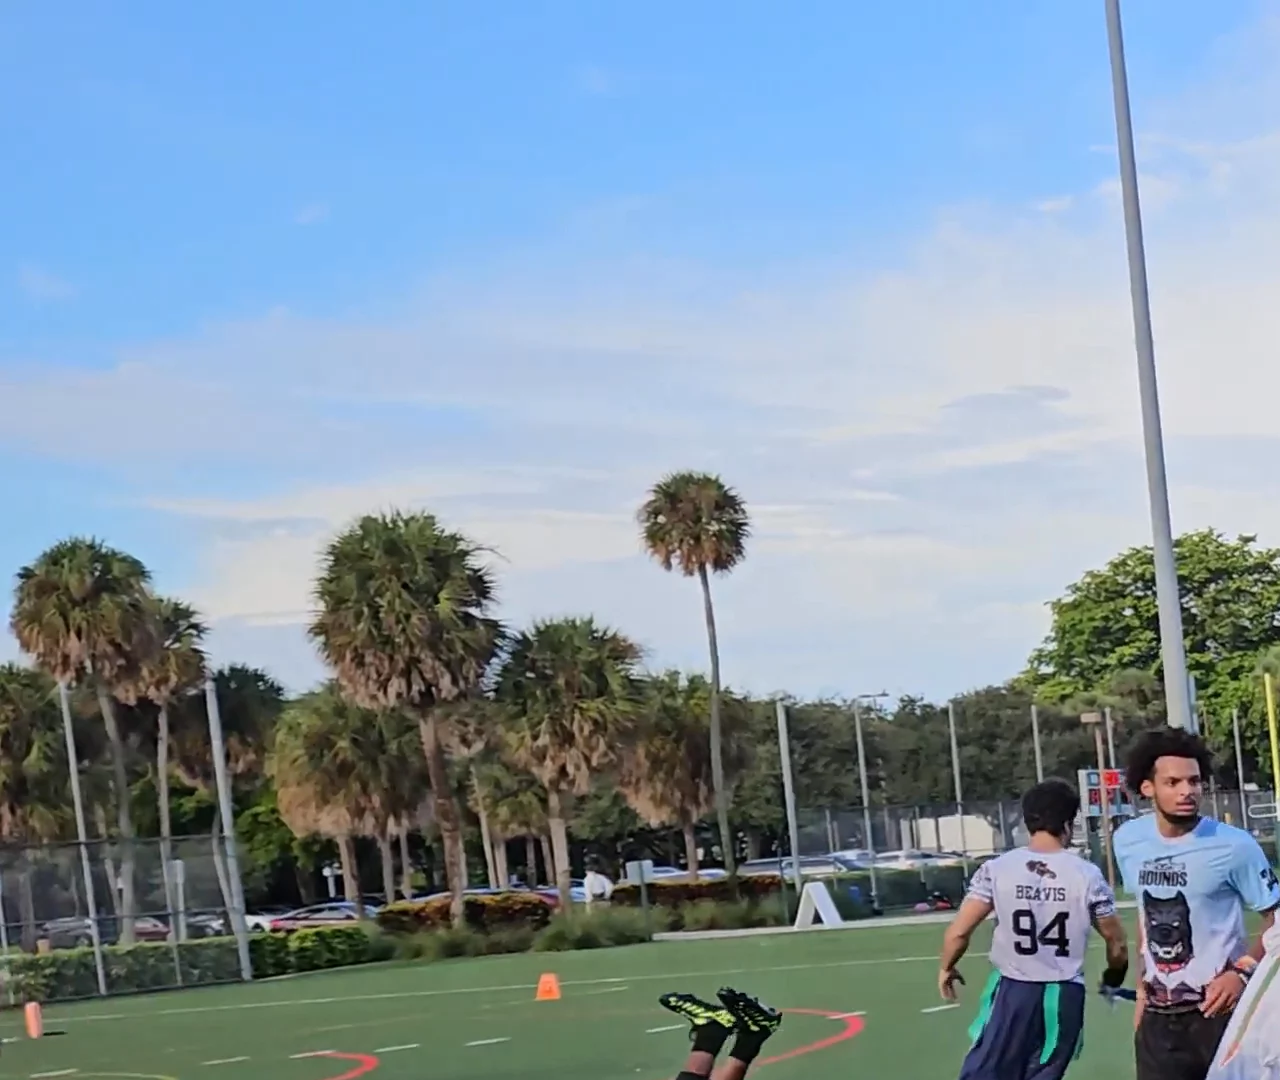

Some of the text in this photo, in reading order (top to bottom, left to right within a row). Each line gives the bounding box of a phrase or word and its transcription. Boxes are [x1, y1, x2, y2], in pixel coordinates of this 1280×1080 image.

[1138, 869, 1188, 887] HOUNDS
[1015, 884, 1066, 902] BEAVIS
[1012, 908, 1070, 957] 94
